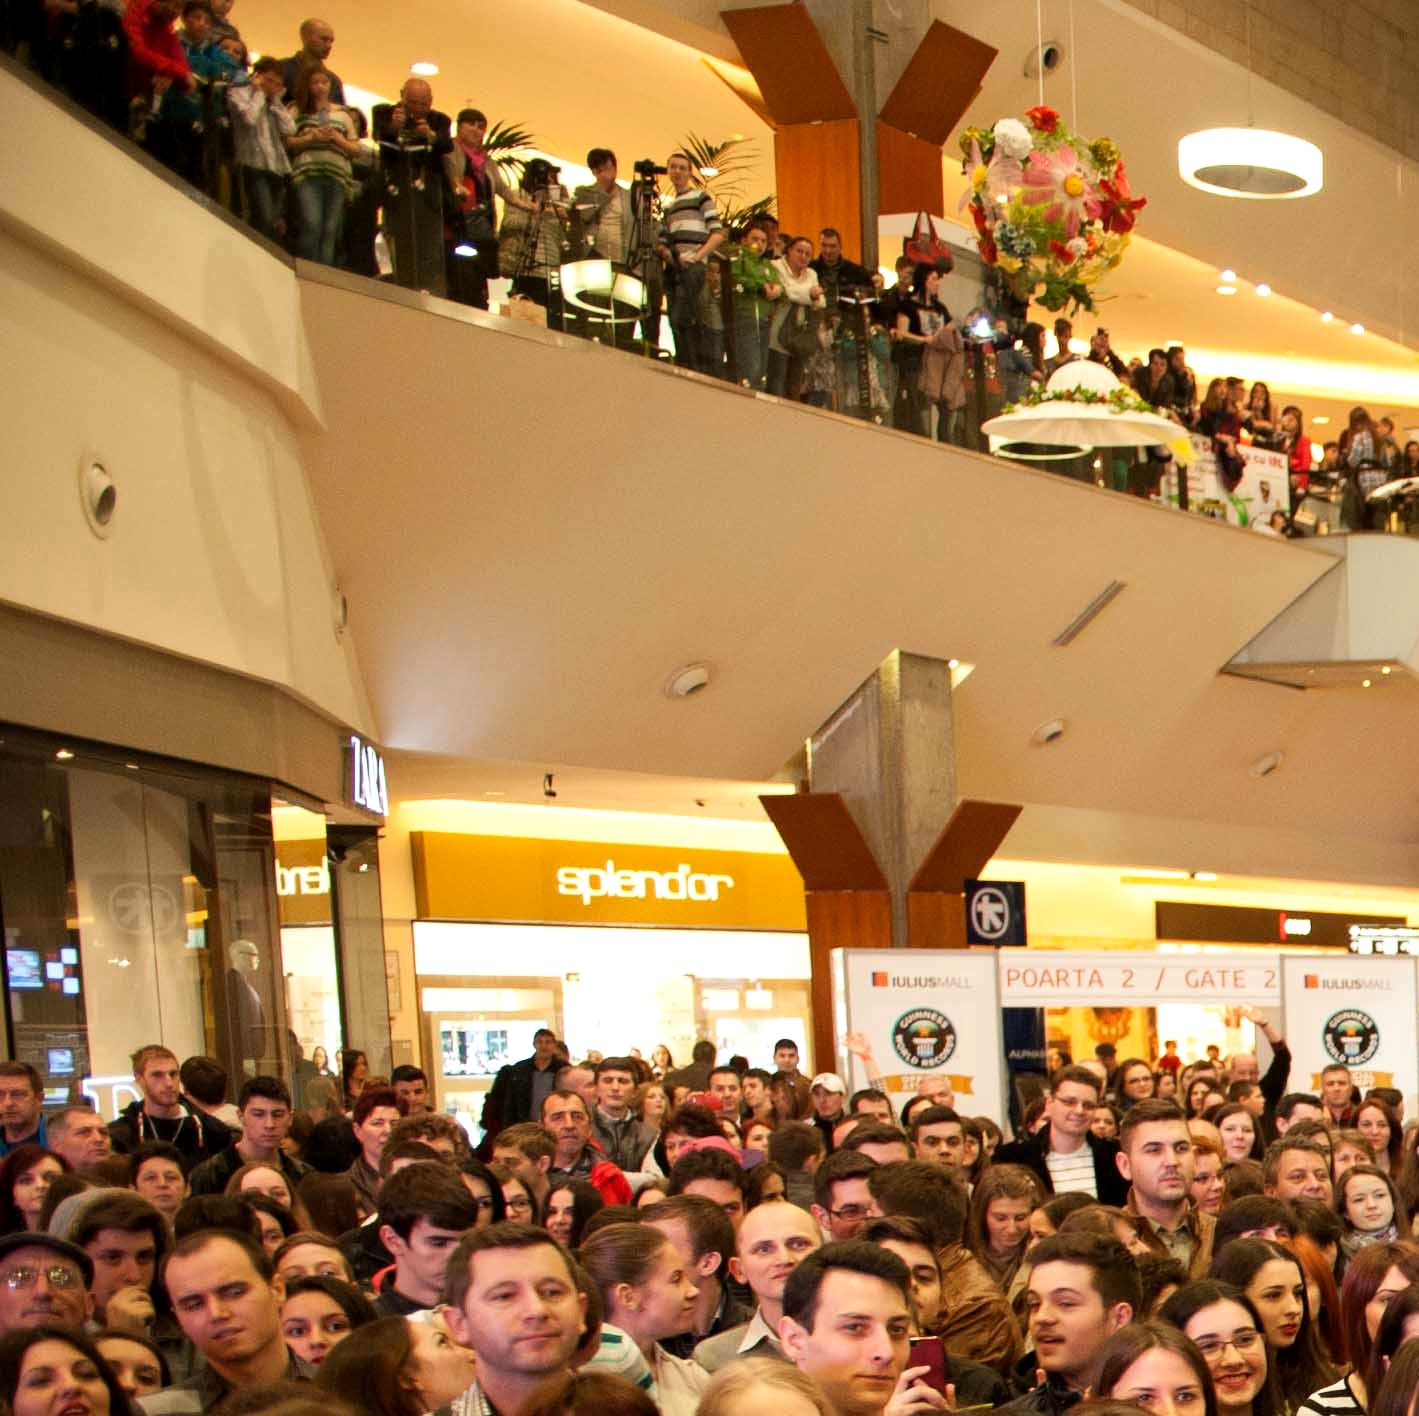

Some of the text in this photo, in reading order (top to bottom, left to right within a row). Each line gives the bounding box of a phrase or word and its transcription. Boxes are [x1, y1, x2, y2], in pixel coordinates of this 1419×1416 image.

[350, 735, 390, 817] ZARA
[1006, 968, 1104, 989] POARTA
[1121, 968, 1135, 989] 2
[1184, 968, 1247, 989] GATE
[1263, 969, 1277, 989] 2
